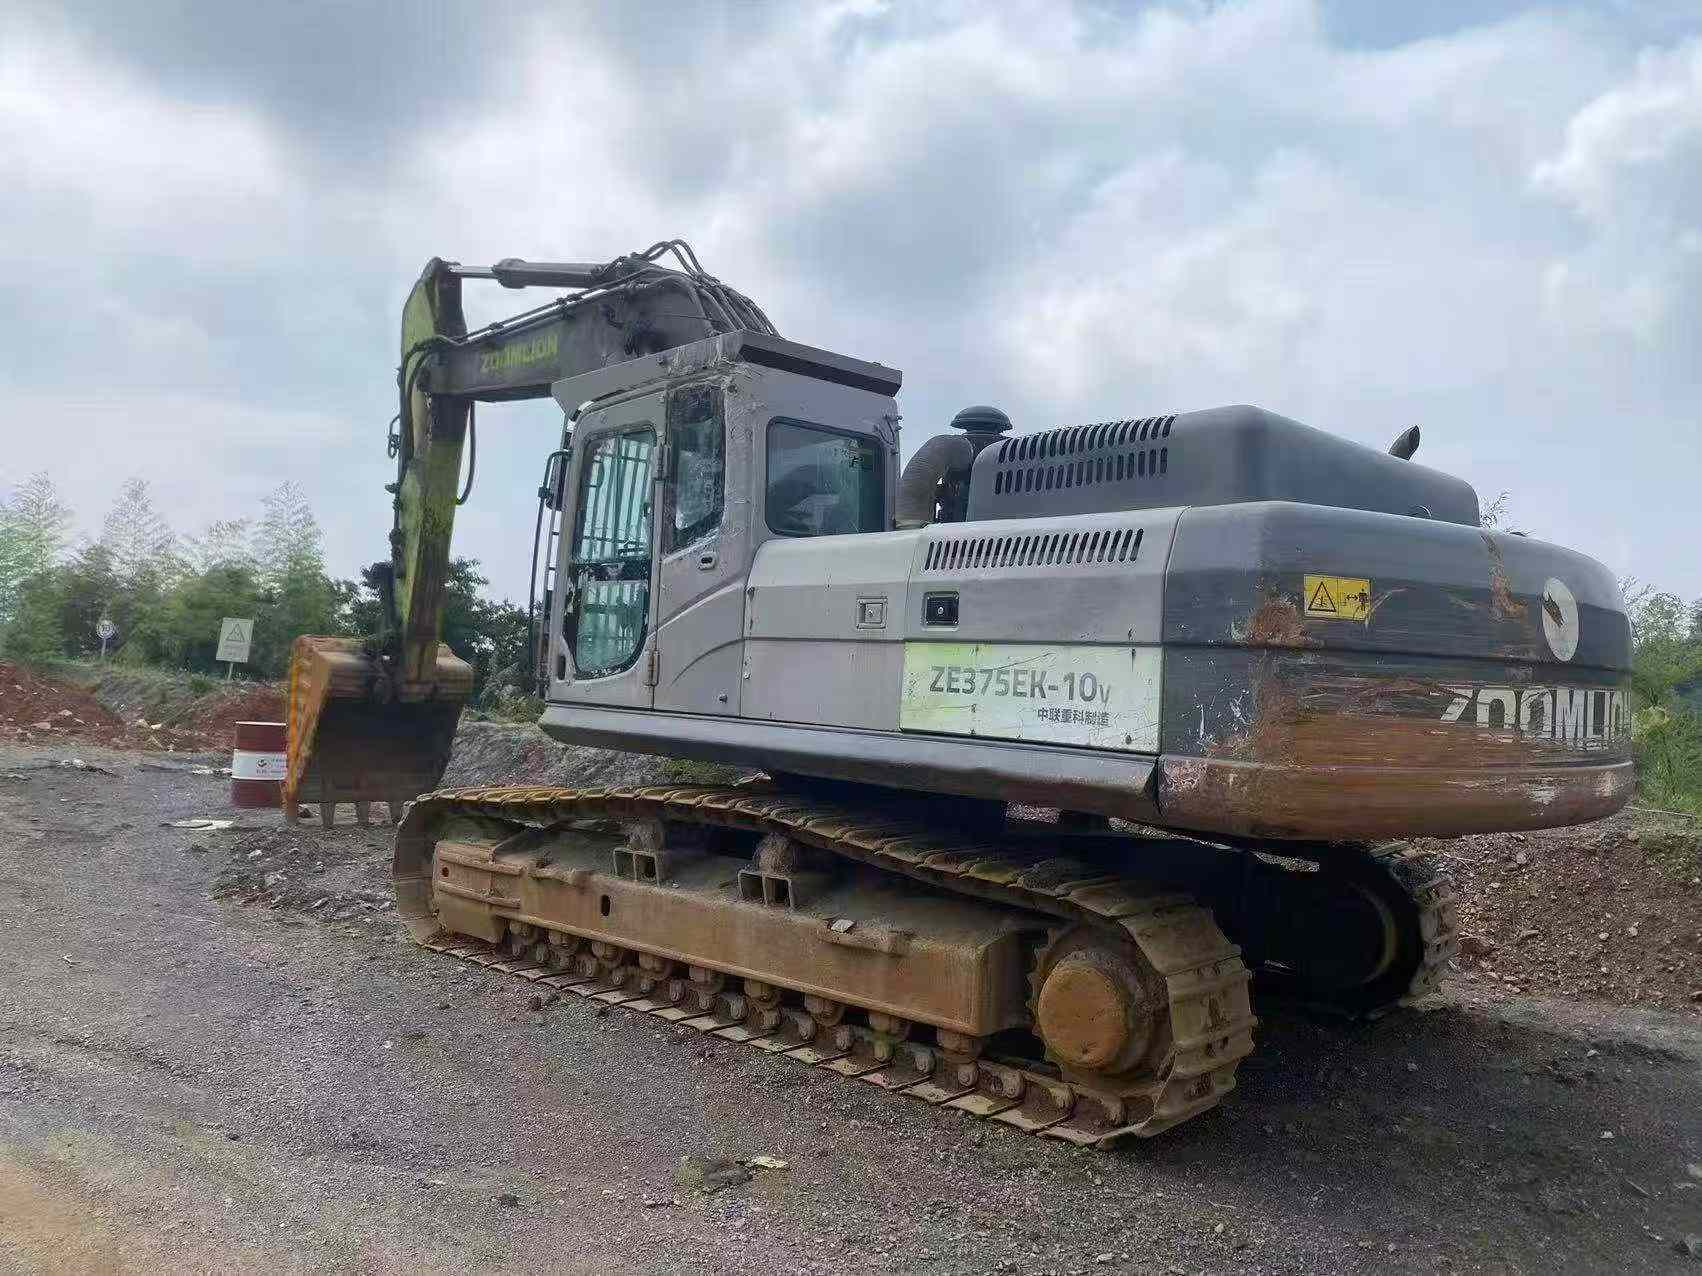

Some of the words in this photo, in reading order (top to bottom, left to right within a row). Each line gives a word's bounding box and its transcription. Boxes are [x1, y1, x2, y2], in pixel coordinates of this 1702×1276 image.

[1037, 706, 1111, 727] 中联重科制造
